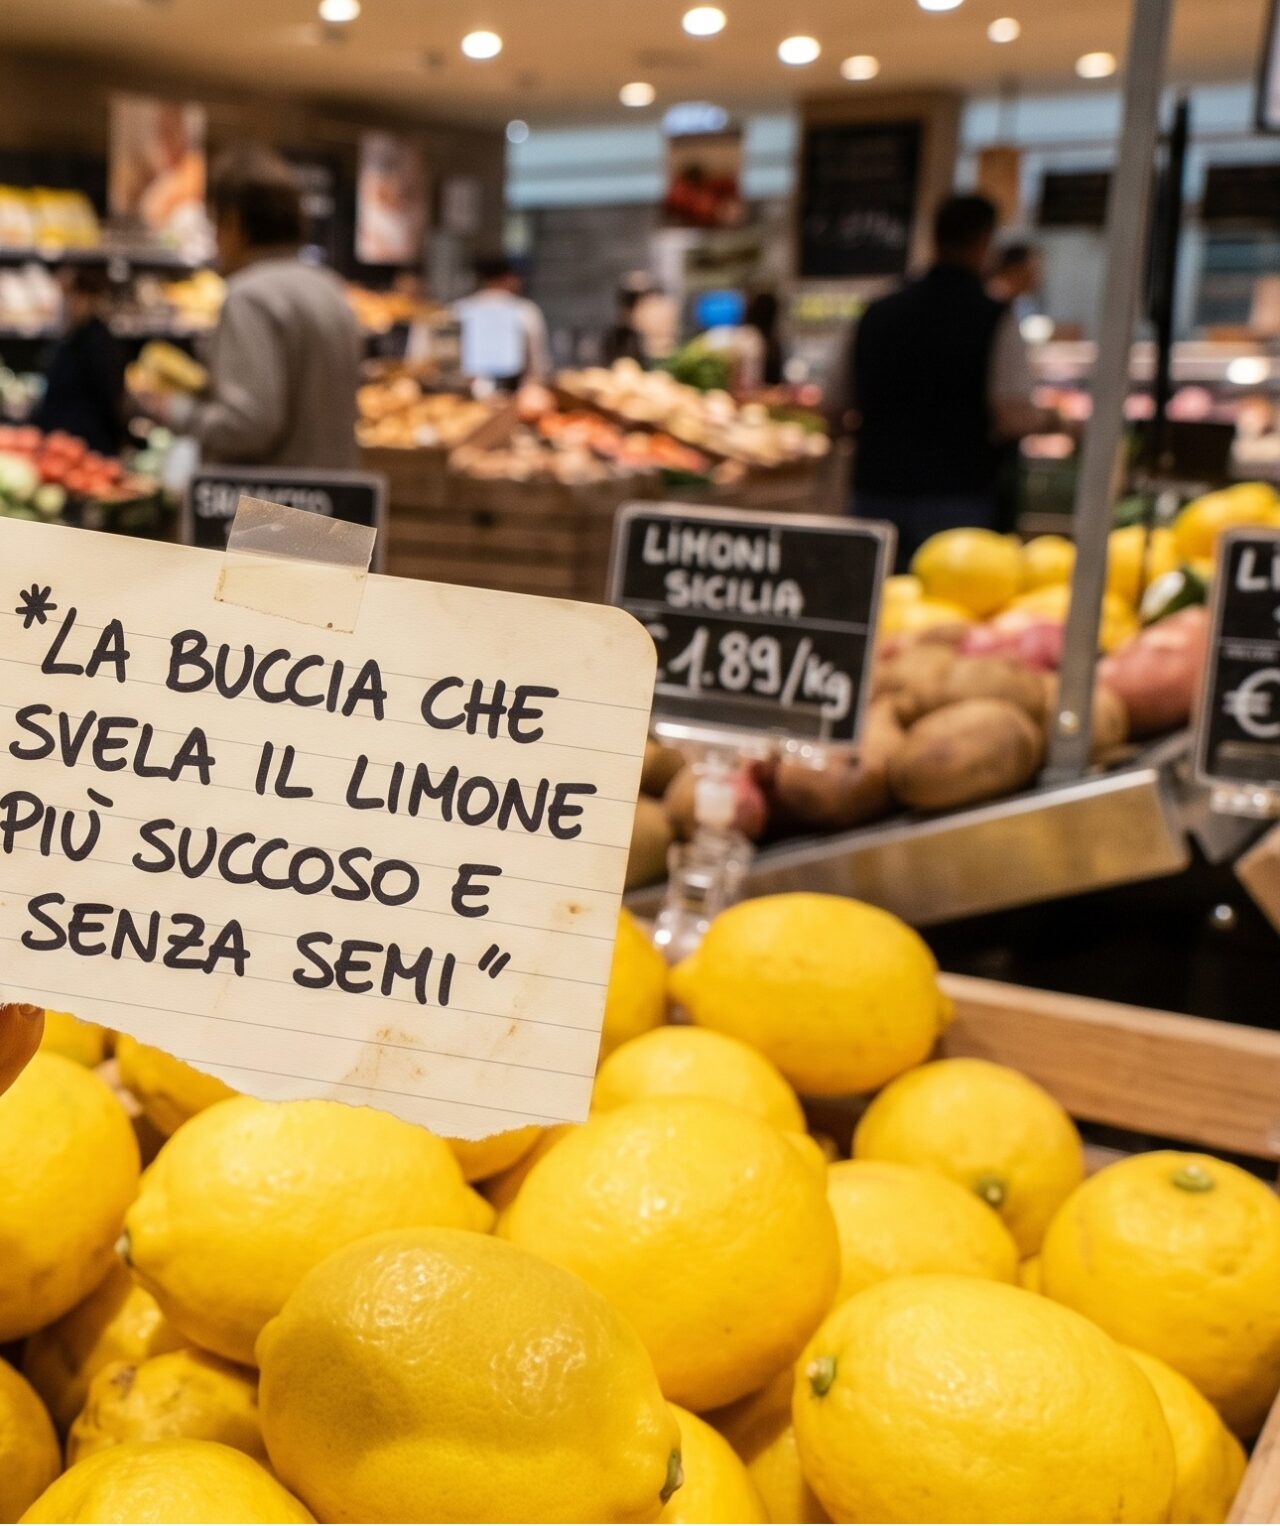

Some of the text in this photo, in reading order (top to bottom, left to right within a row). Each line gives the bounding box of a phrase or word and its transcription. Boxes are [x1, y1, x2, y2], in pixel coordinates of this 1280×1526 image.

[664, 569, 804, 619] SICILIA
[166, 630, 387, 720] BUCCIA
[421, 677, 559, 743] CHE
[9, 704, 597, 839] SVELA IL LIMONE
[0, 788, 502, 917] PIÙ SUCCOSO E
[21, 893, 250, 976] SENZA
